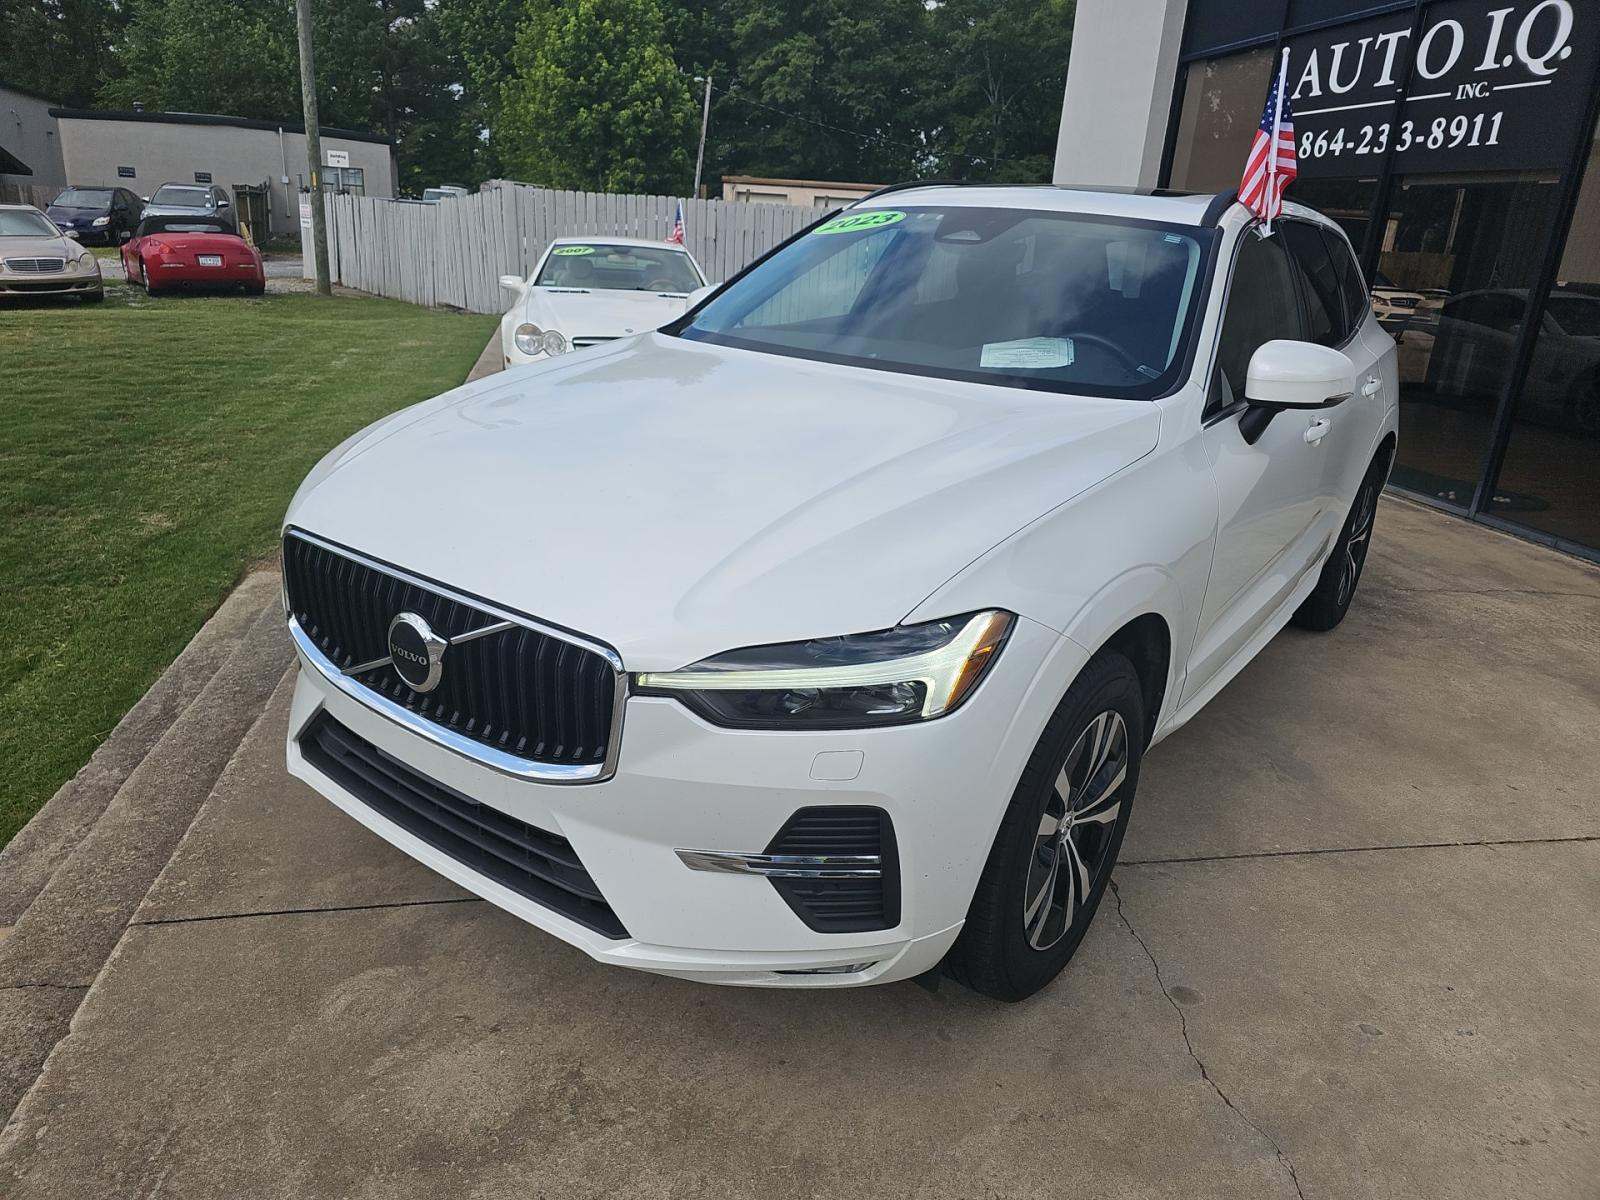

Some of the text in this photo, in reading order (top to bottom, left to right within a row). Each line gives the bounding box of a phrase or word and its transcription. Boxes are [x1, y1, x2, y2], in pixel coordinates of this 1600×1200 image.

[1291, 0, 1574, 100] AUTO I.Q.
[1456, 81, 1490, 101] INC.
[1299, 112, 1504, 159] 864-233-8911
[820, 213, 898, 232] 2023
[392, 644, 428, 666] VOLVO
